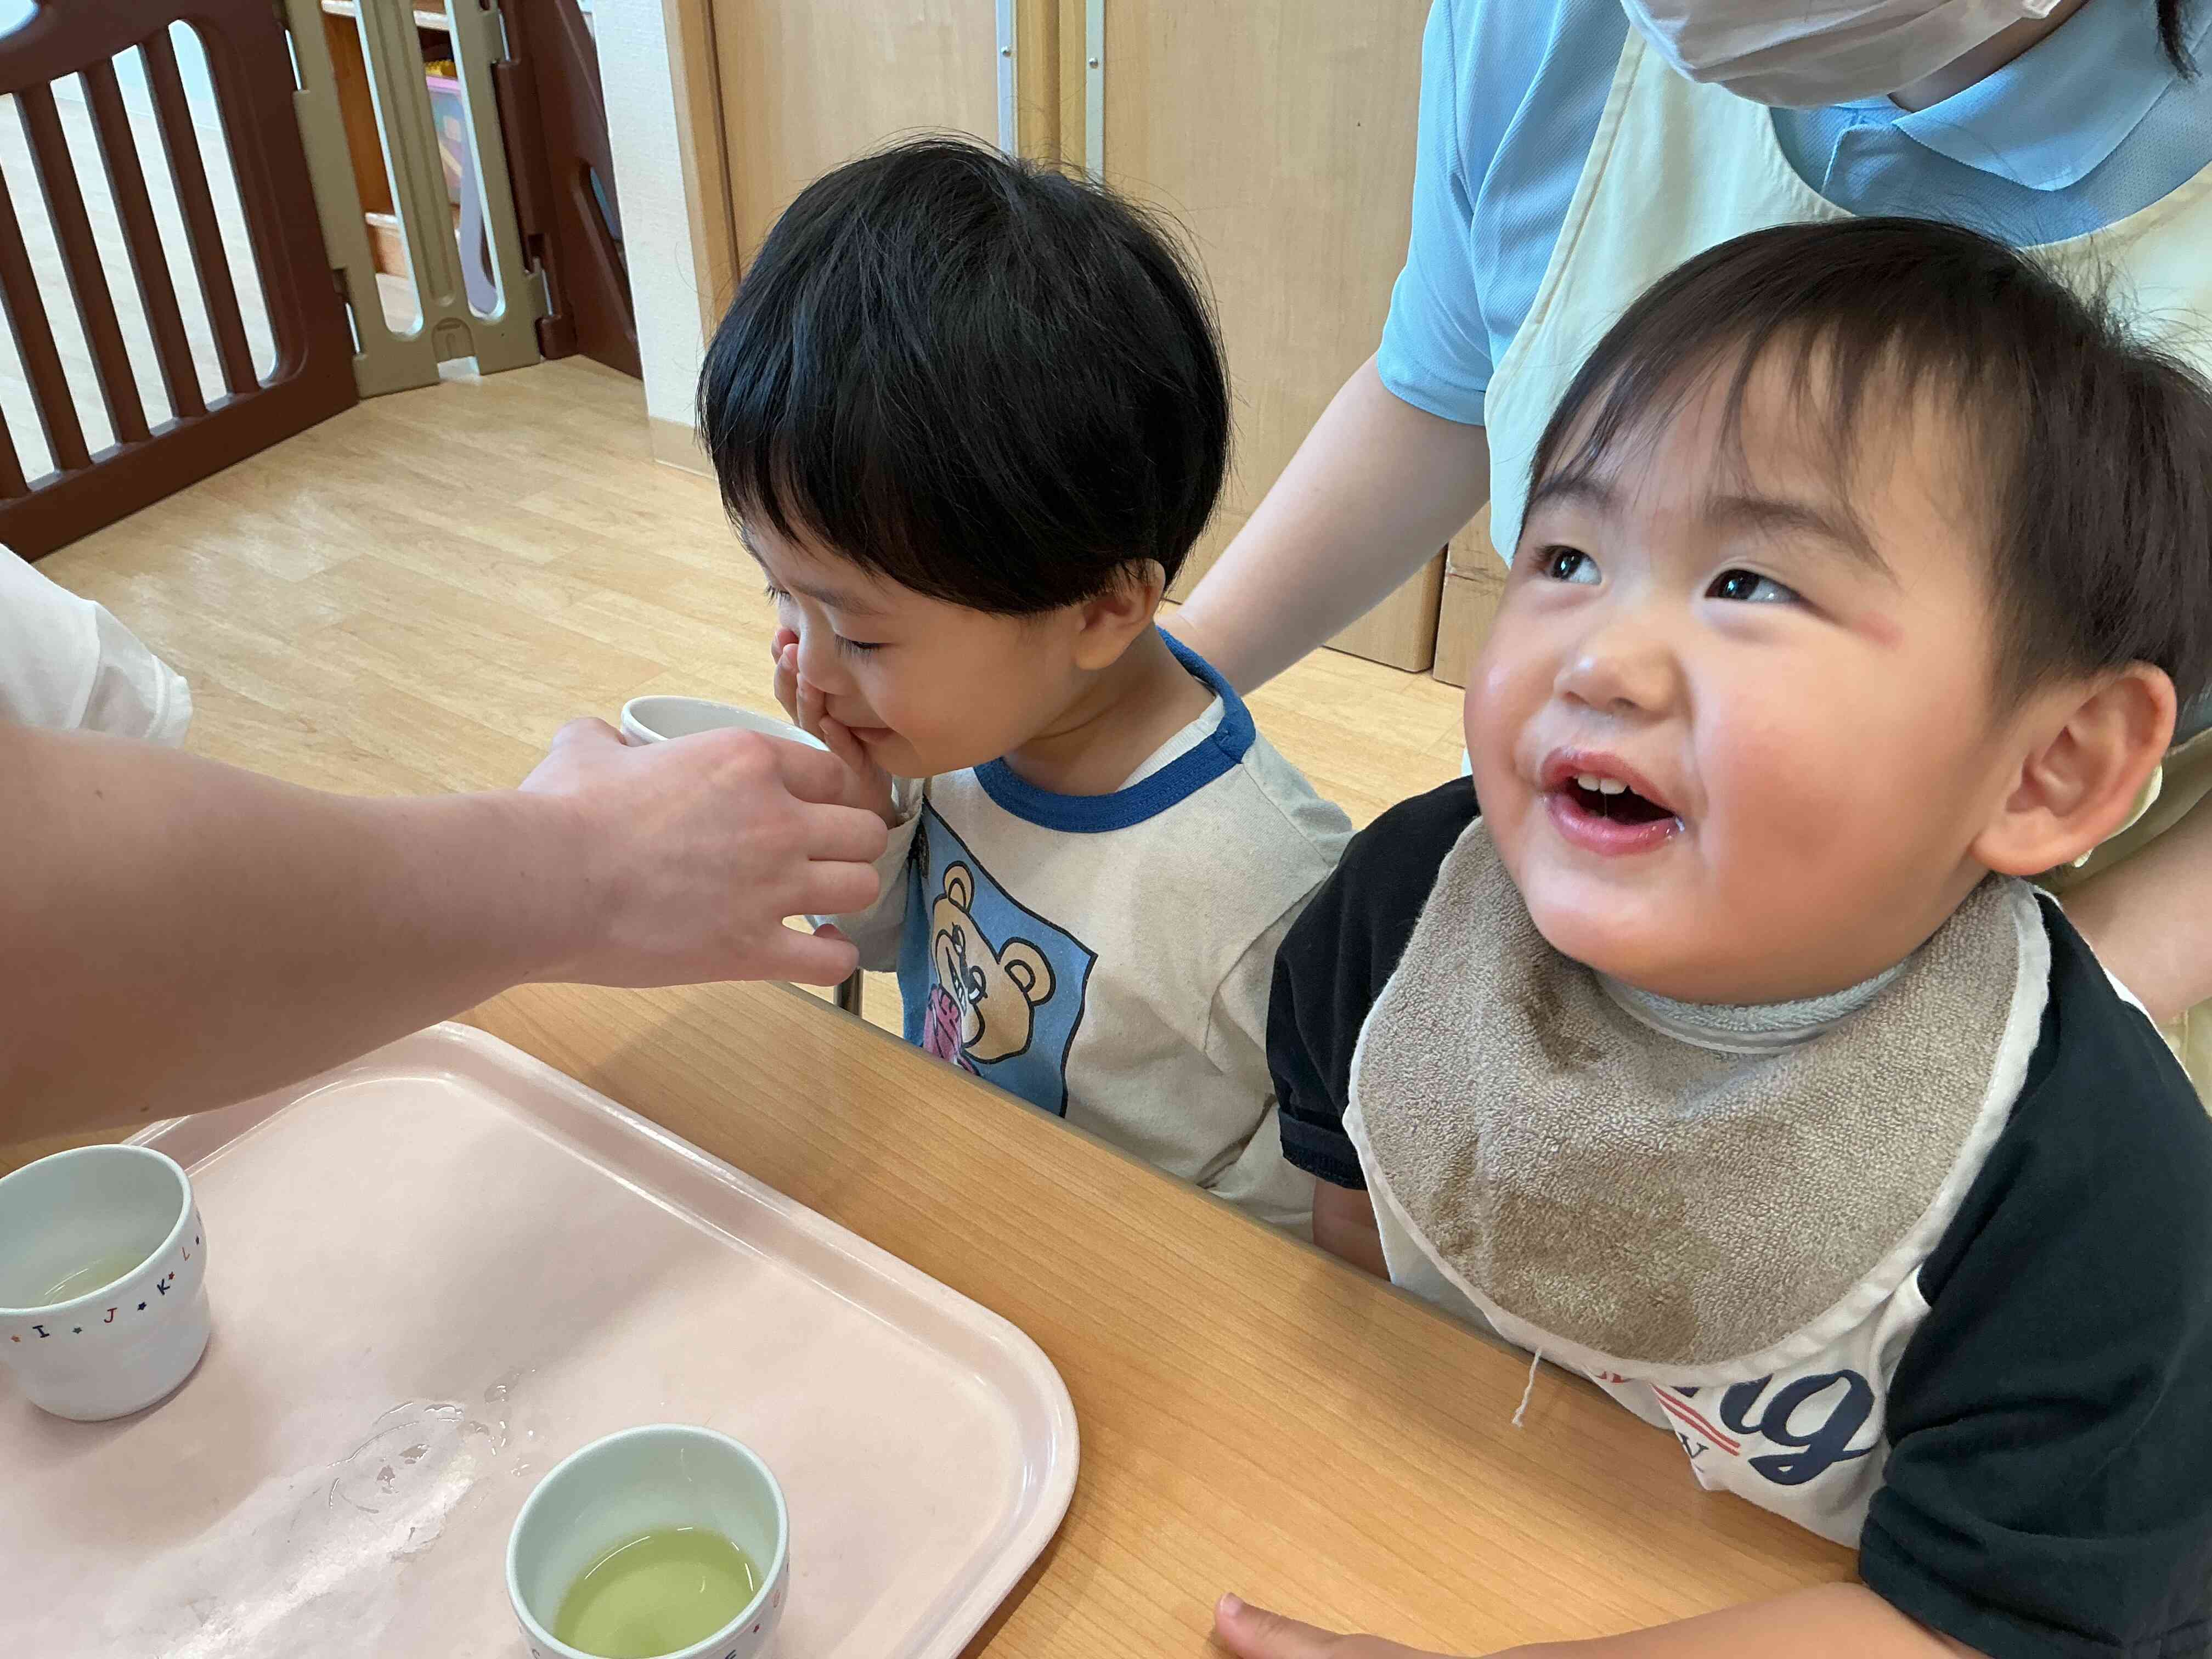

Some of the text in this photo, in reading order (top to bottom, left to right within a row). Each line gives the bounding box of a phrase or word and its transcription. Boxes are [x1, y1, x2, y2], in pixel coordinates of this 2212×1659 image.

[32, 1325, 50, 1338] I
[104, 1307, 117, 1323] J
[157, 1279, 170, 1295] K
